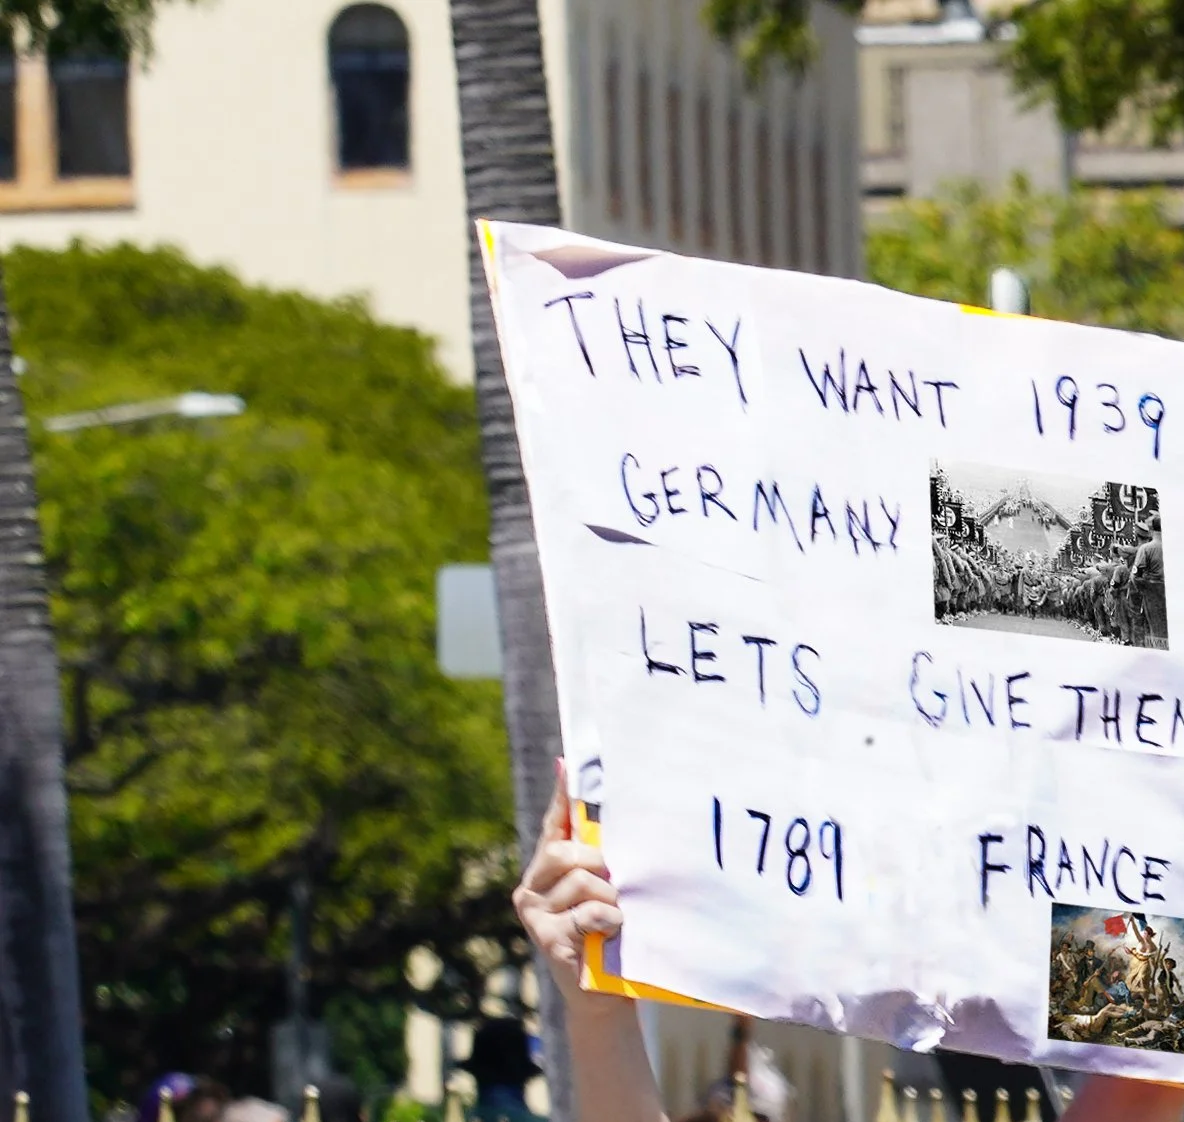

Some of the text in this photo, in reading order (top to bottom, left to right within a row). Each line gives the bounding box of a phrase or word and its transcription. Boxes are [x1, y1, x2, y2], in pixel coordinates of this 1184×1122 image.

[545, 291, 1166, 459] THEY WANT 1939
[621, 452, 902, 555] GERMANY
[639, 605, 823, 718] LETS
[910, 651, 1031, 729] GIVE
[712, 796, 1173, 907] 1789 FRANCE
